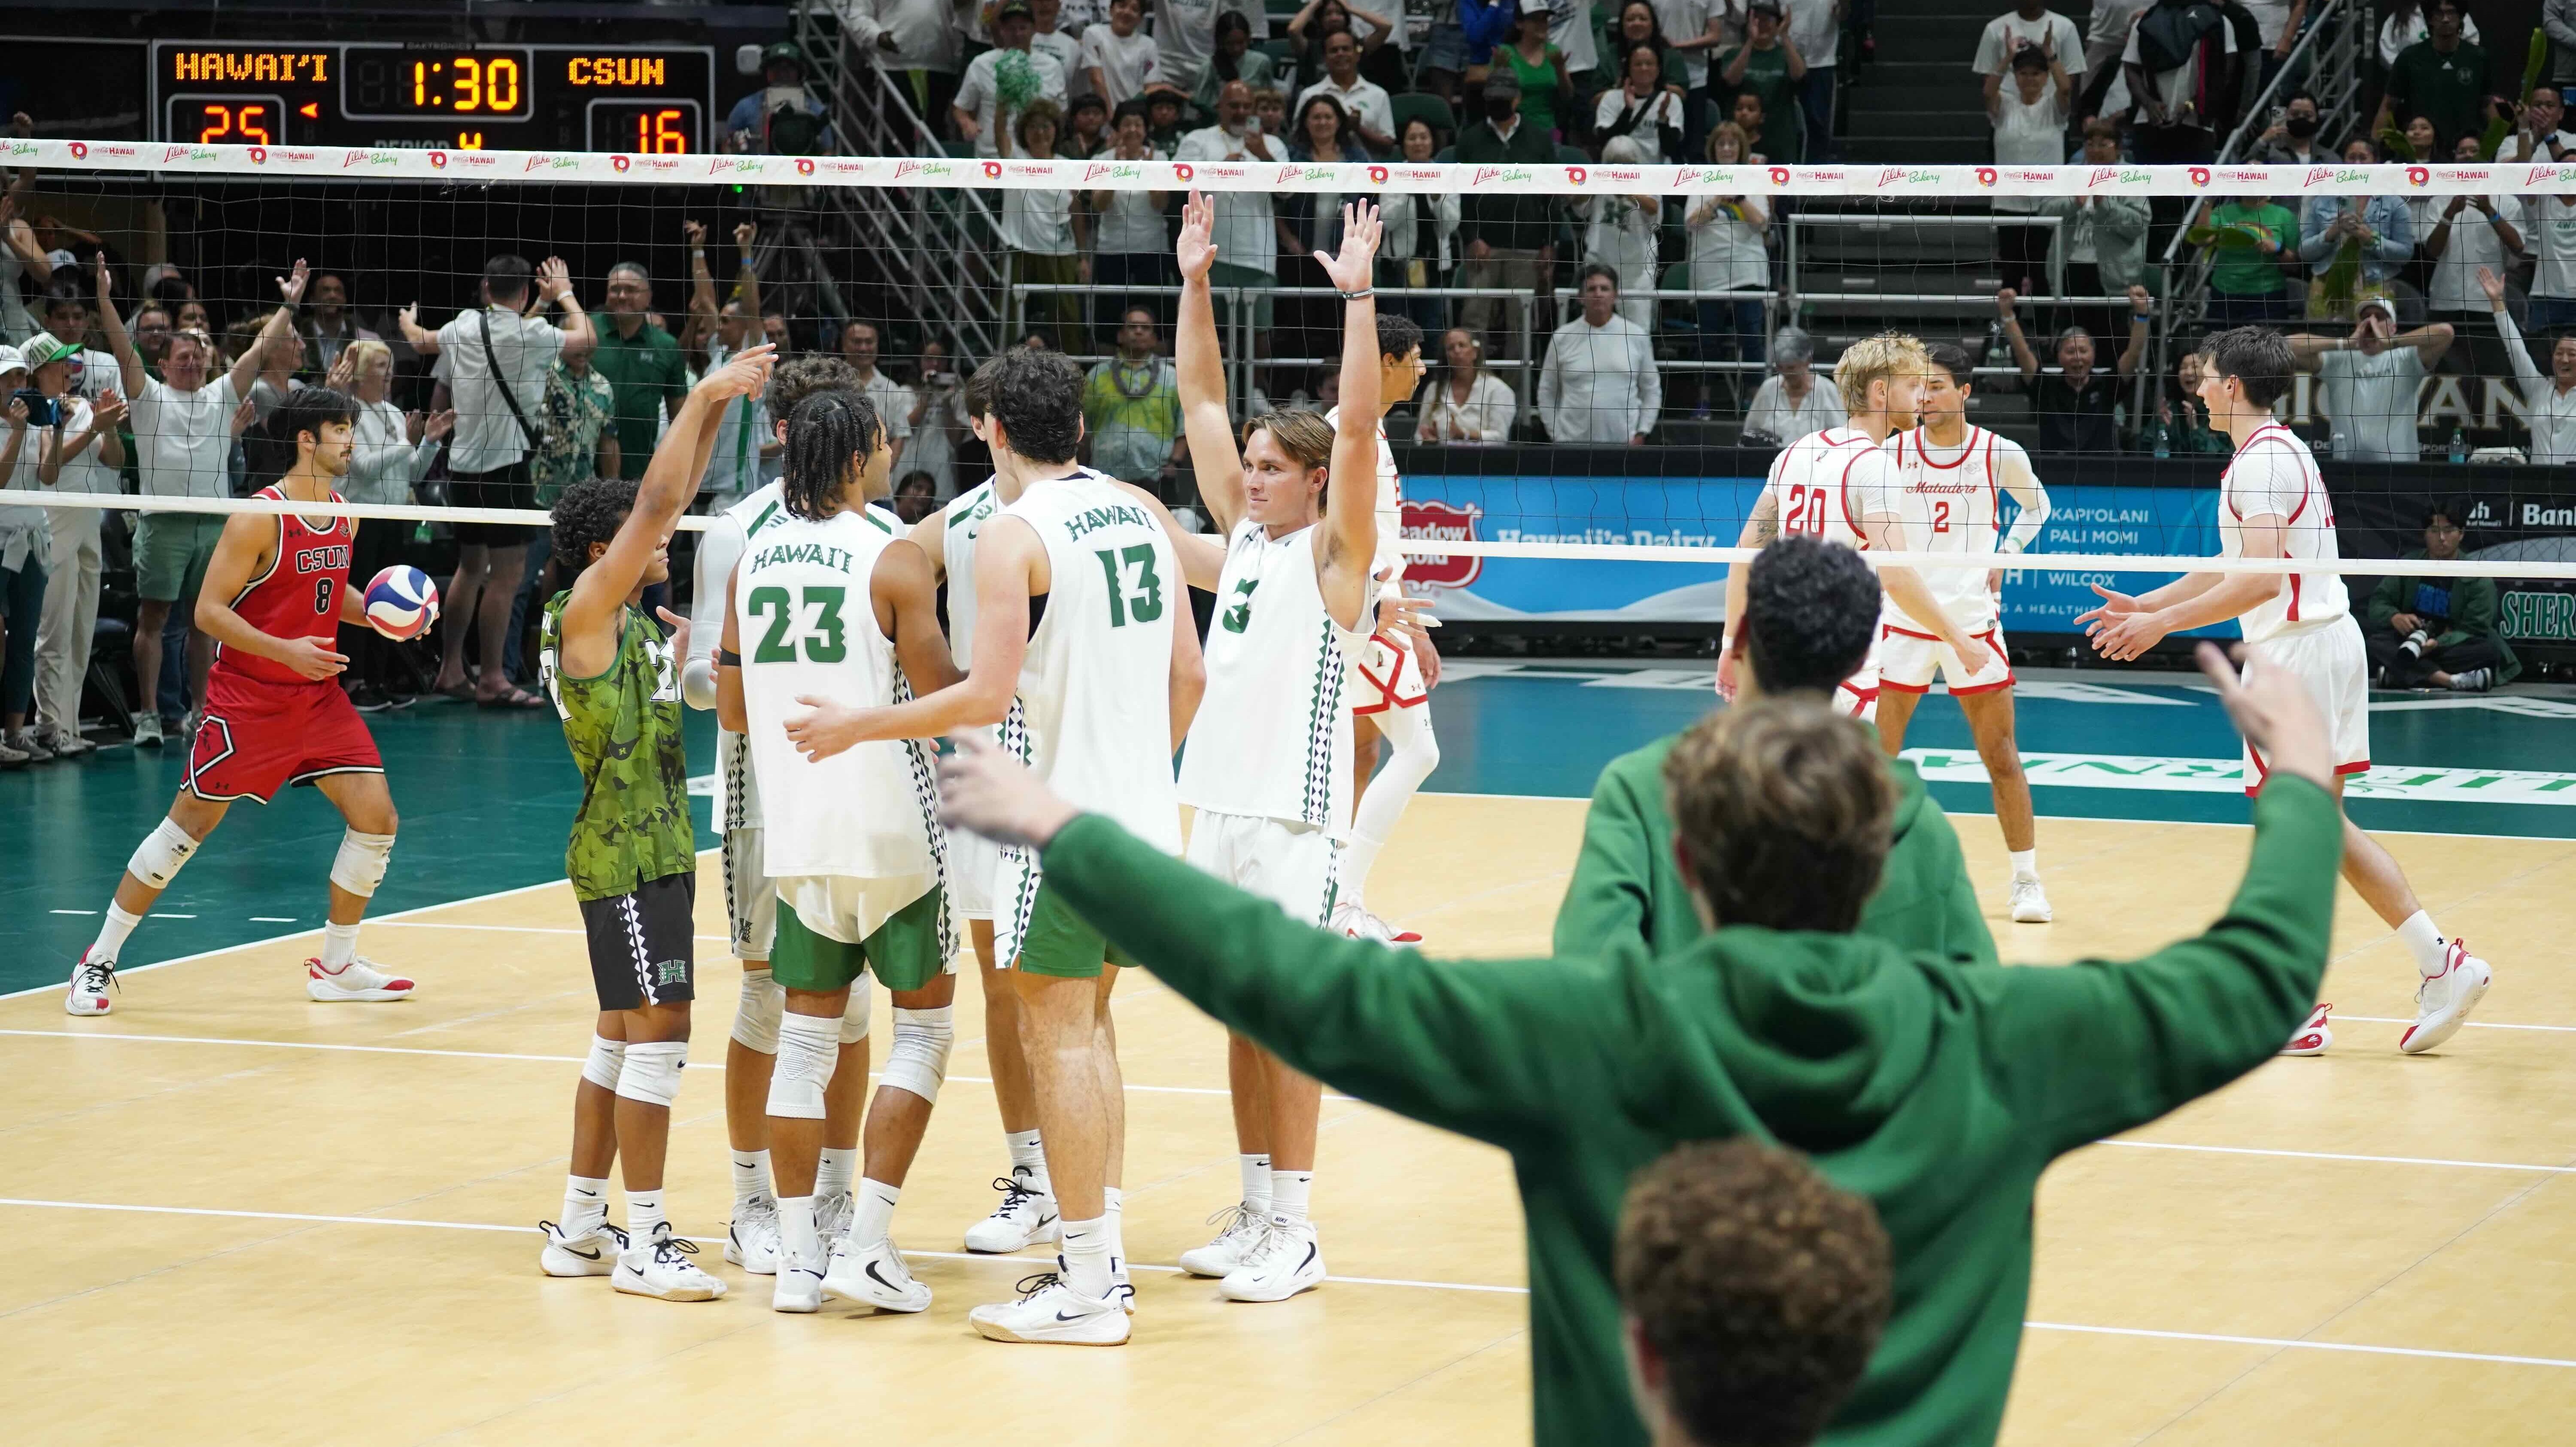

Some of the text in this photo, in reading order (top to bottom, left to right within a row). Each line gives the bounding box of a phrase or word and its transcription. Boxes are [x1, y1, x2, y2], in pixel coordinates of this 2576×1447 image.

[176, 52, 328, 82] HAWAI'I
[568, 58, 664, 85] CSUN
[414, 57, 518, 111] 1:30
[201, 106, 268, 145] 25
[640, 111, 686, 154] 16
[526, 155, 579, 172] Liliha Bakery
[709, 158, 763, 175] Liliha Bakery
[895, 160, 952, 179] Liliha Bakery
[1084, 163, 1141, 181] Liliha Bakery
[1277, 165, 1334, 183] Liliha Bakery
[1473, 167, 1532, 185] Liliha Bakery
[1673, 167, 1734, 187] Liliha Bakery
[1878, 168, 1941, 187] Liliha Bakery
[2088, 167, 2152, 188] Liliha Bakery
[2304, 167, 2369, 187] Liliha Bakery
[2525, 166, 2557, 186] Liliha
[1906, 481, 1978, 494] Matadors
[1785, 483, 1827, 540] 20
[1934, 502, 1950, 533] 2
[2523, 503, 2576, 526] Ban
[2050, 529, 2139, 544] PALI MOMI
[295, 544, 350, 575] CSUN
[1095, 543, 1163, 629] 13
[2048, 573, 2115, 587] WILCOX
[314, 577, 334, 615] 8
[748, 585, 847, 664] 23
[748, 1195, 760, 1205] NIKE
